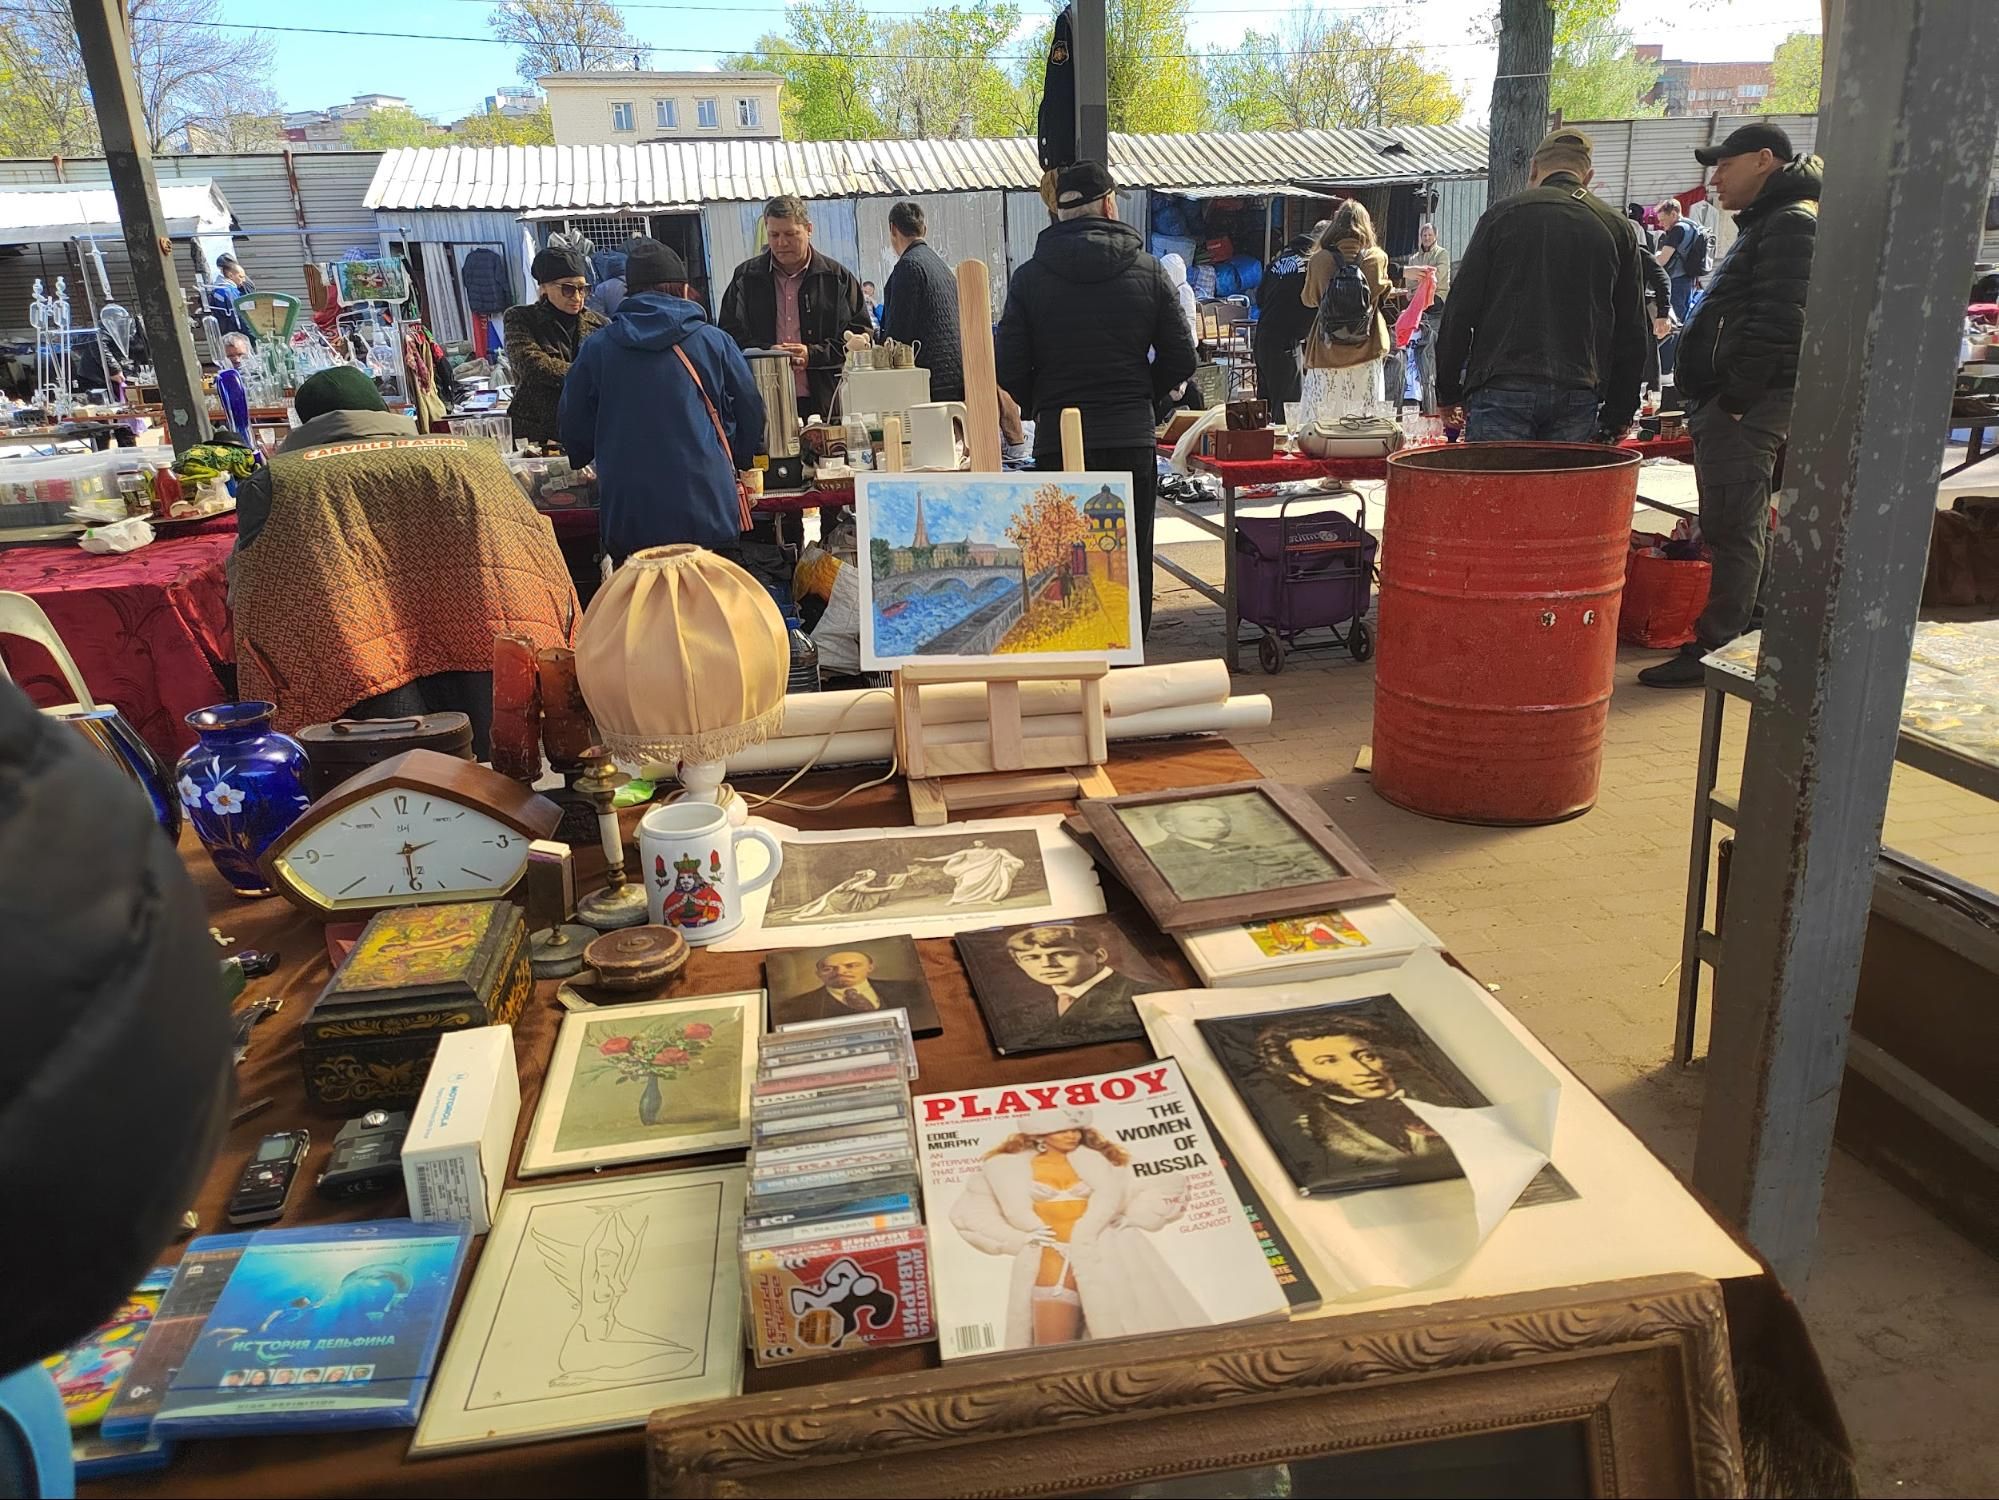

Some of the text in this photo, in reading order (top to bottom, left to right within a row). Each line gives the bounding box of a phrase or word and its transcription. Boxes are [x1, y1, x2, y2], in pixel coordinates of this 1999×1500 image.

[304, 439, 466, 460] CARVILLE RACING
[394, 795, 408, 815] 12
[496, 834, 509, 848] 3
[306, 849, 319, 864] 9
[409, 877, 422, 891] 6
[923, 1068, 1168, 1122] PLAYBOY
[440, 1086, 458, 1127] MOTOROLA
[1147, 1101, 1185, 1119] THE
[927, 1131, 959, 1142] EDDIE
[1116, 1117, 1192, 1142] WOMEN
[928, 1138, 980, 1150] MURPHY
[1174, 1134, 1198, 1151] OF
[930, 1157, 985, 1168] INTERVIEW
[1132, 1153, 1208, 1177] RUSSIA
[931, 1166, 983, 1177] THAT SAYS
[1185, 1171, 1213, 1182] FROM
[1186, 1180, 1216, 1191] INSIDE
[1163, 1194, 1184, 1205] THE
[1191, 1198, 1225, 1210] NAKED
[1188, 1206, 1228, 1221] LOOK AT
[1179, 1216, 1232, 1233] GLASNOST
[896, 1250, 918, 1338] АВАРИЯ
[911, 1248, 930, 1335] ДИСКОТЕКА
[232, 1335, 395, 1366] ИСТОРИЯ ДЕЛЬФИНА
[130, 1385, 152, 1398] 0+
